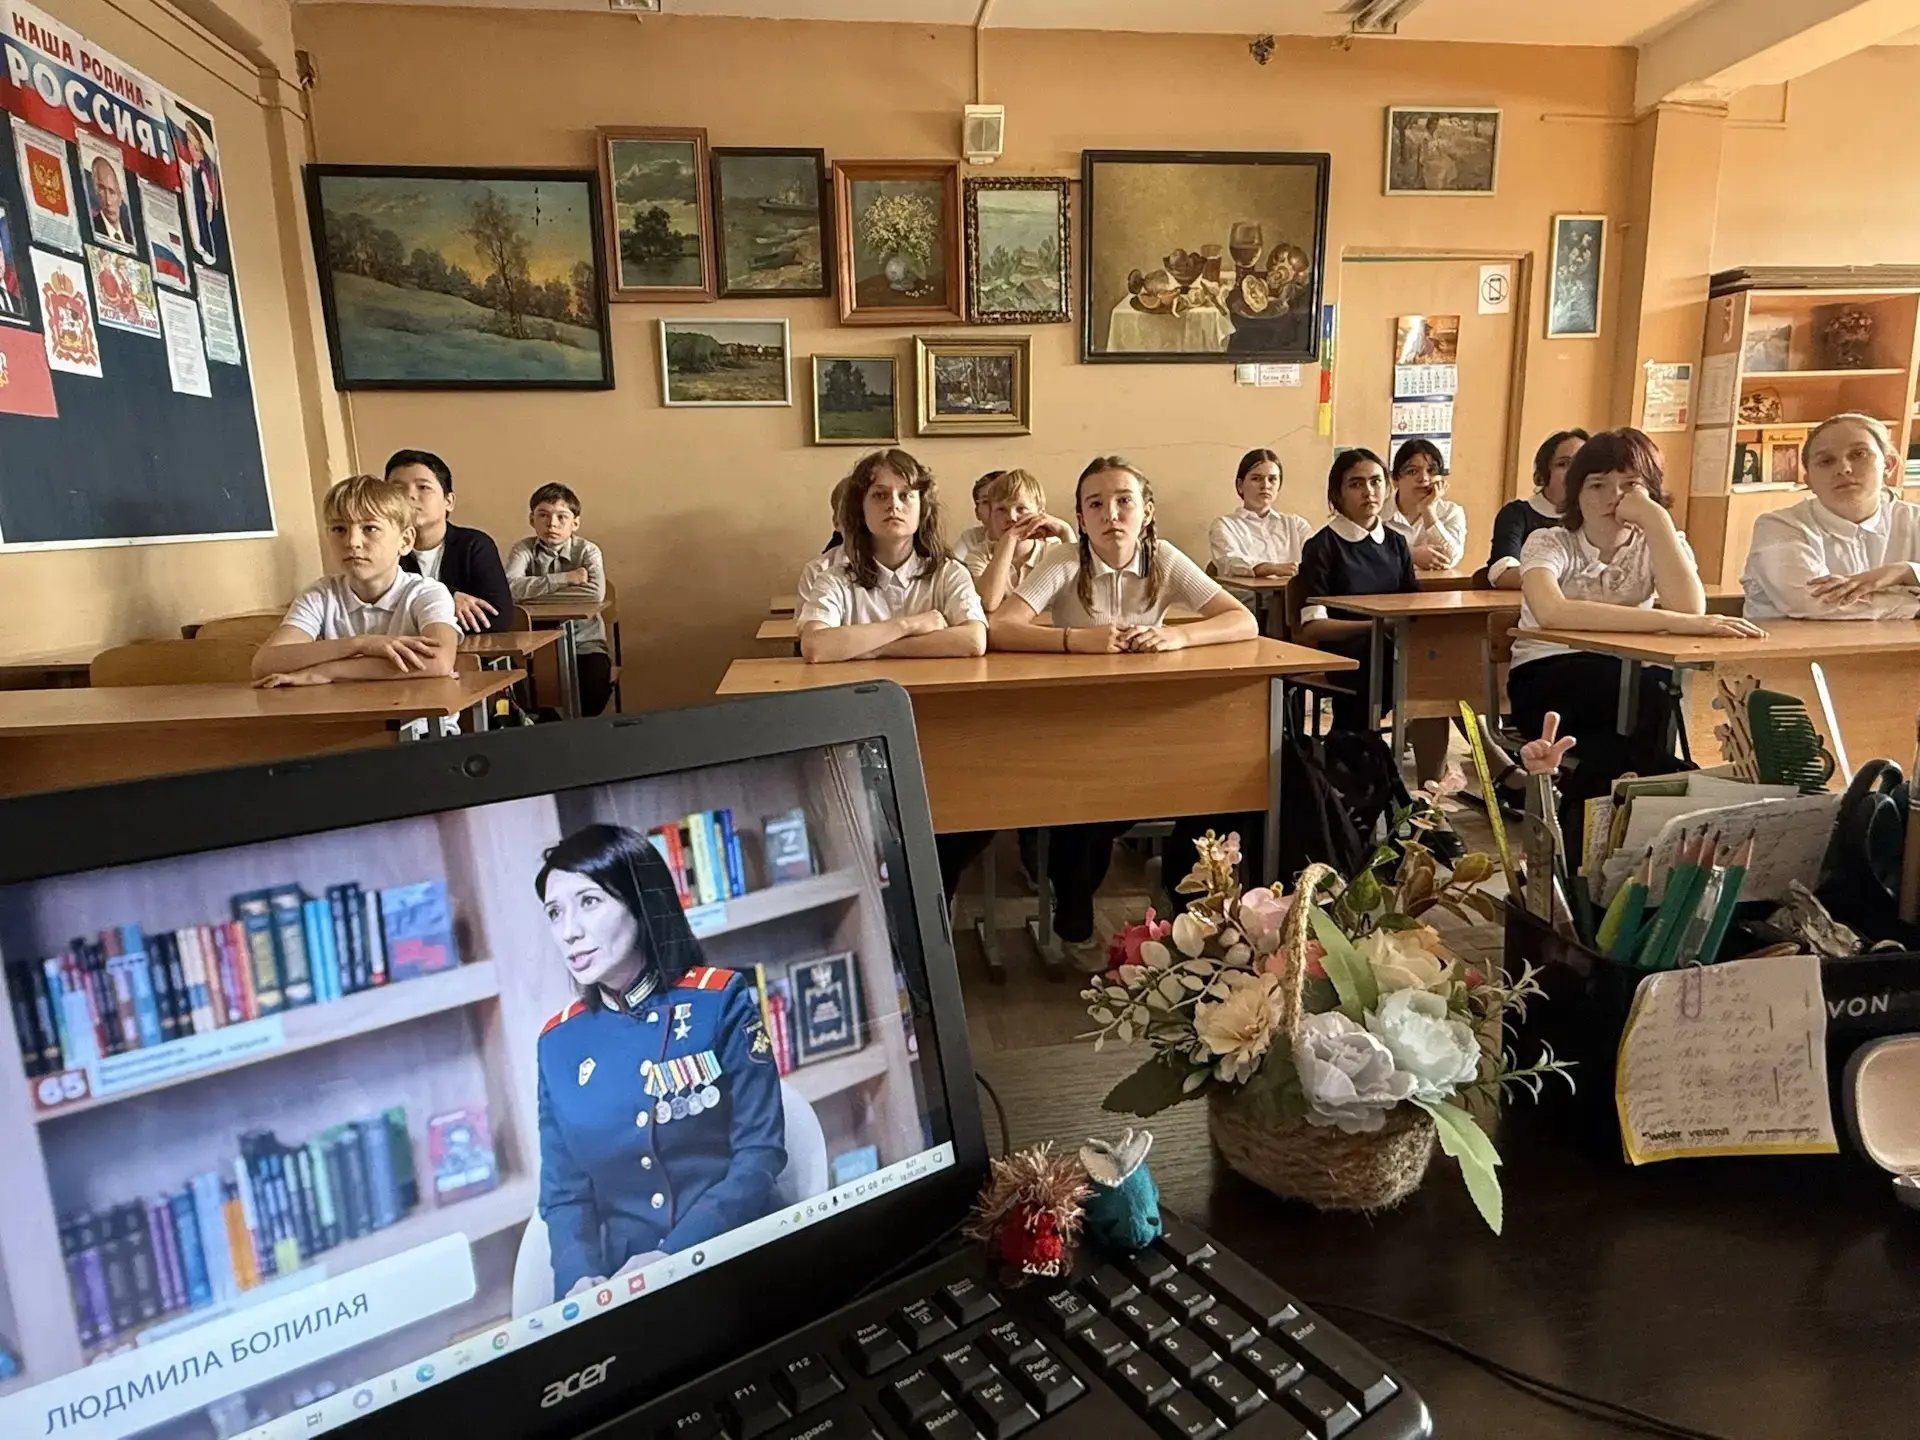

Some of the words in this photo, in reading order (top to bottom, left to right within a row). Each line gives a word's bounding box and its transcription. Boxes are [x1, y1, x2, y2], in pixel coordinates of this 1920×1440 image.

[12, 12, 75, 67] НАША
[4, 43, 171, 165] РОССИЯ!
[1827, 993, 1890, 1019] VON
[1650, 1129, 1683, 1141] weber
[1165, 1282, 1178, 1294] 9
[903, 1298, 926, 1314] Scroll
[1126, 1304, 1140, 1317] 8
[1204, 1314, 1219, 1326] 6
[857, 1323, 878, 1337] Print
[859, 1327, 888, 1345] Screen
[991, 1321, 1016, 1337] Page
[1003, 1331, 1019, 1343] Up
[1084, 1328, 1096, 1340] 7
[1291, 1322, 1316, 1341] Enter
[1164, 1337, 1179, 1350] 5
[943, 1344, 972, 1362] Home
[1248, 1349, 1262, 1361] 3
[45, 1349, 223, 1435] ЛЮДМИЛА
[230, 1293, 370, 1363] БОЛИЛАЯ
[788, 1356, 812, 1372] F12
[1026, 1356, 1050, 1373] Page
[1126, 1363, 1138, 1375] 4
[540, 1355, 616, 1408] acer
[895, 1369, 926, 1390] Insert
[1033, 1364, 1061, 1383] Down
[1208, 1375, 1224, 1388] 2
[734, 1384, 757, 1400] F11
[981, 1383, 1003, 1399] End
[1166, 1404, 1180, 1416] 1
[677, 1412, 702, 1428] F10
[924, 1408, 960, 1431] Delete
[789, 1418, 834, 1440] space
